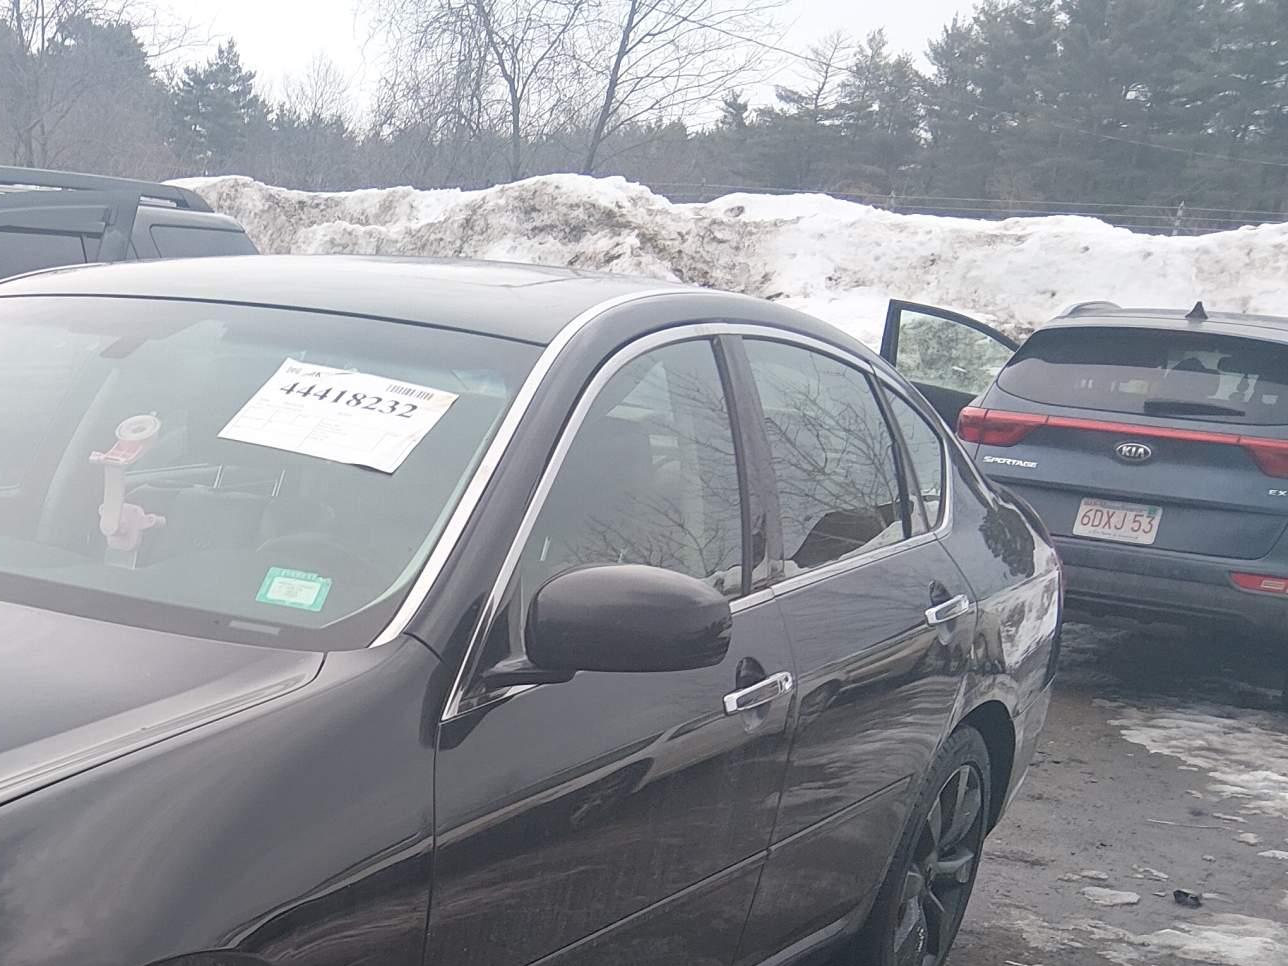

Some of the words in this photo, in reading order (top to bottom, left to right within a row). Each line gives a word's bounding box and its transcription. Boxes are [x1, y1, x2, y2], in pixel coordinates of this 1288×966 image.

[279, 381, 418, 419] 44418232
[1120, 446, 1146, 458] KIA
[983, 455, 1039, 469] SPORTAGE
[1268, 489, 1288, 497] EX
[1080, 508, 1128, 530] 6DXJ
[1130, 513, 1156, 534] 53
